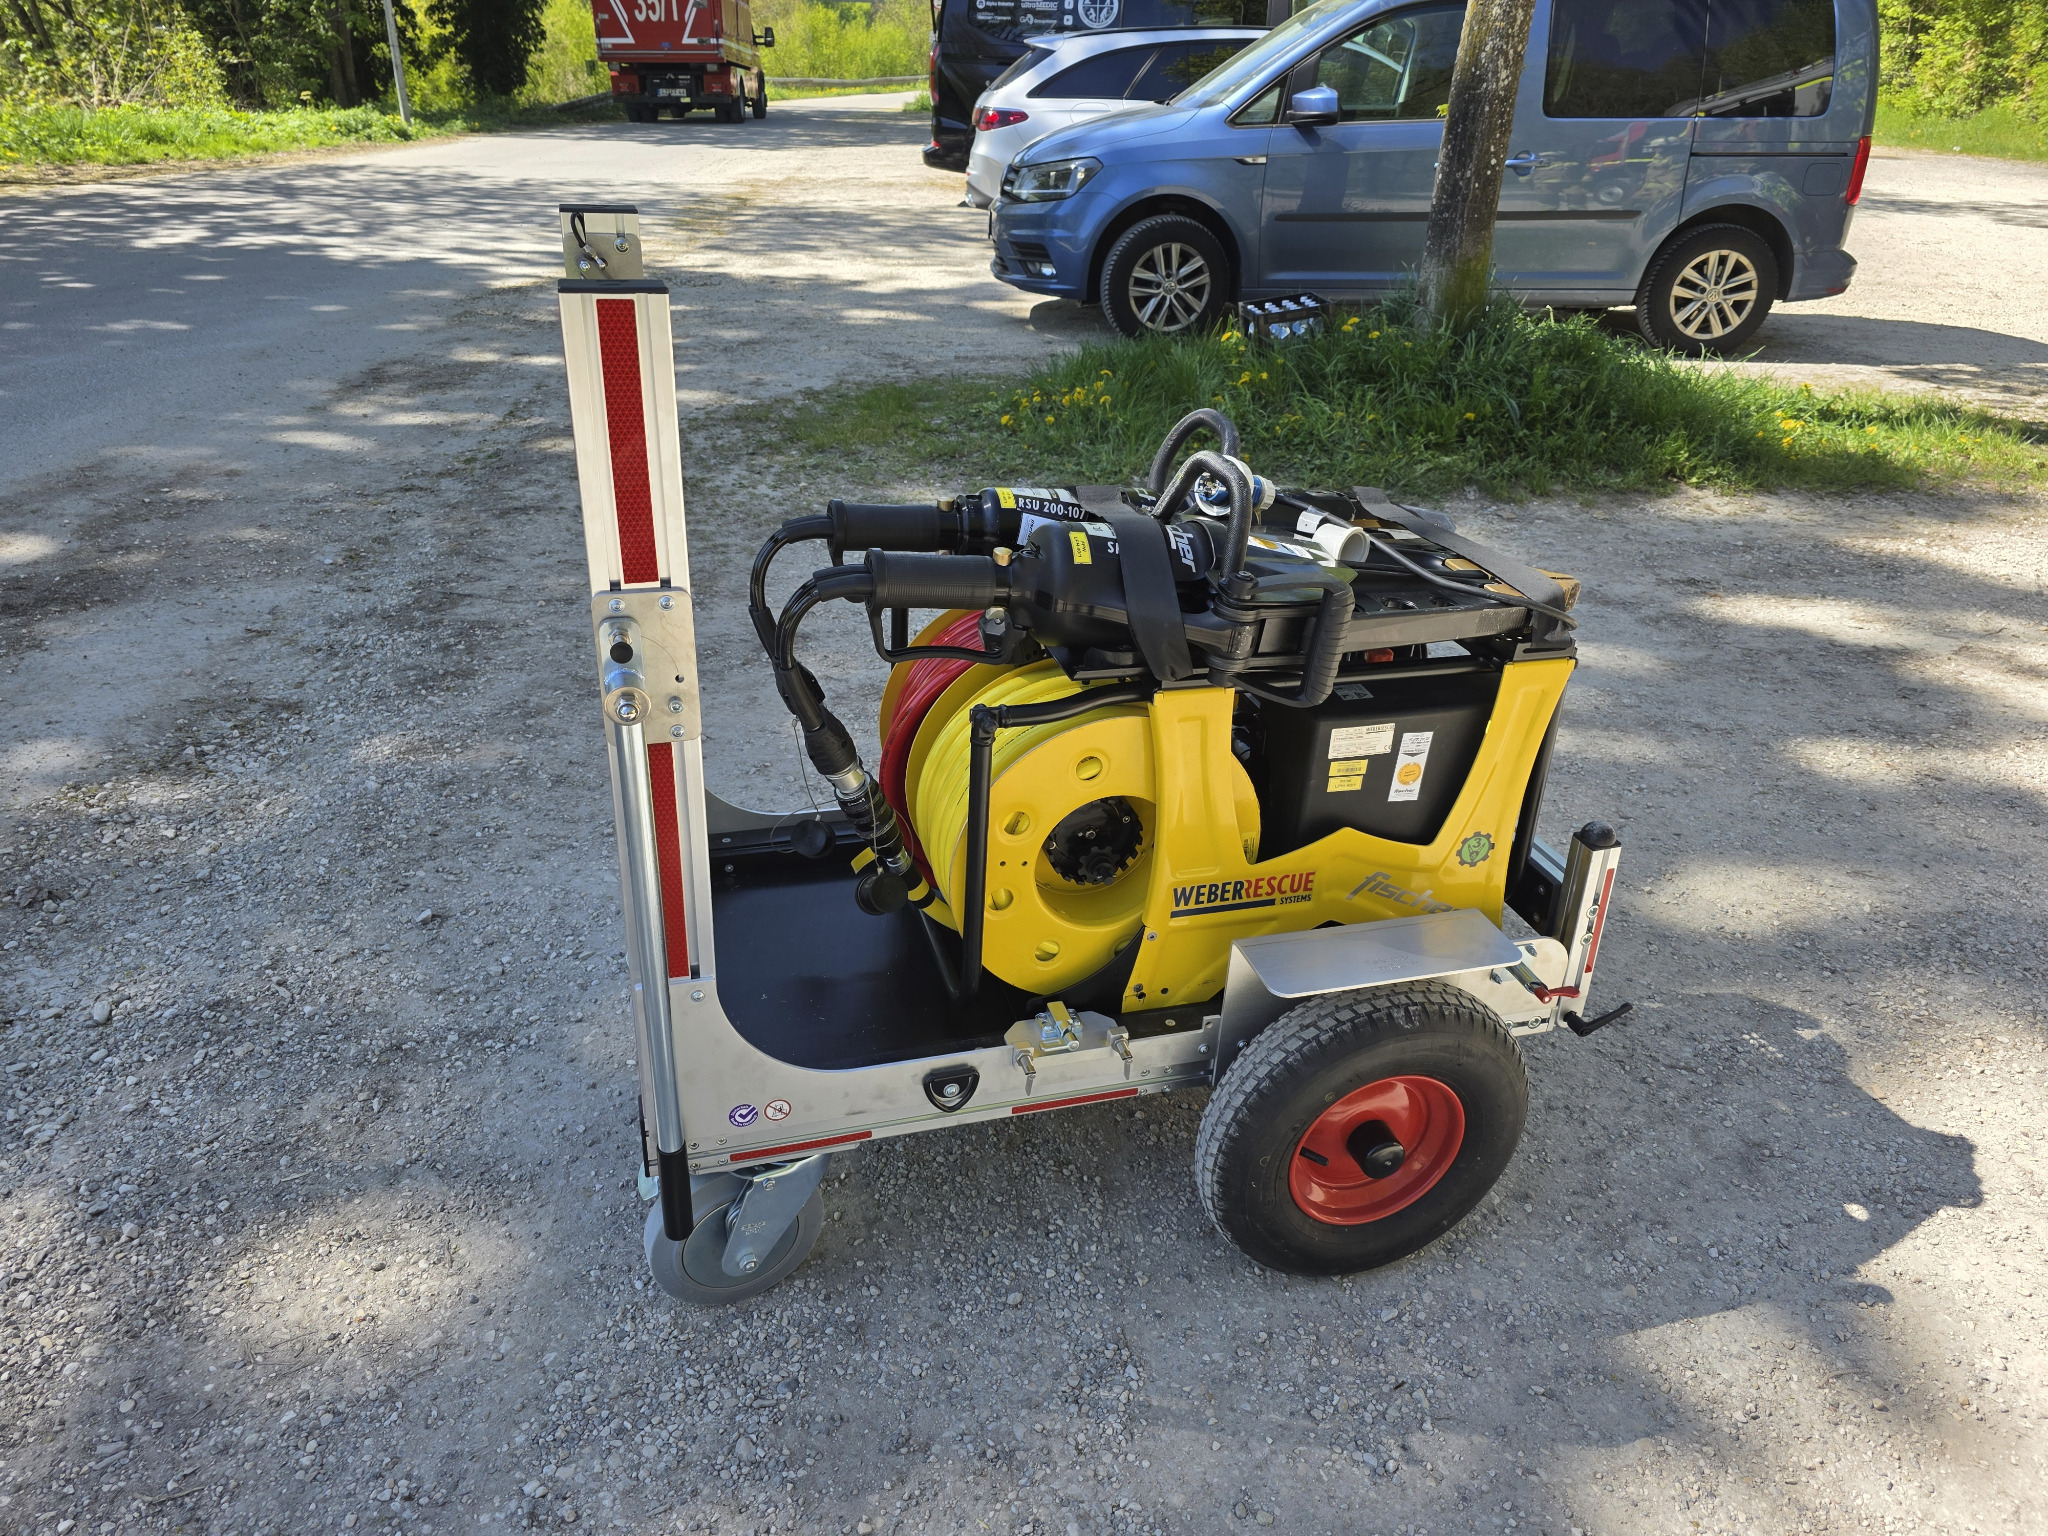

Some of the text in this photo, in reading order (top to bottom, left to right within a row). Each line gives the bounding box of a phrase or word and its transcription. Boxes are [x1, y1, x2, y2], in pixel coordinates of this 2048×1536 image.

[1018, 498, 1086, 520] RSU 200-107
[1472, 838, 1482, 848] 3
[1280, 894, 1312, 905] SYSTEMS
[1345, 871, 1461, 914] fische
